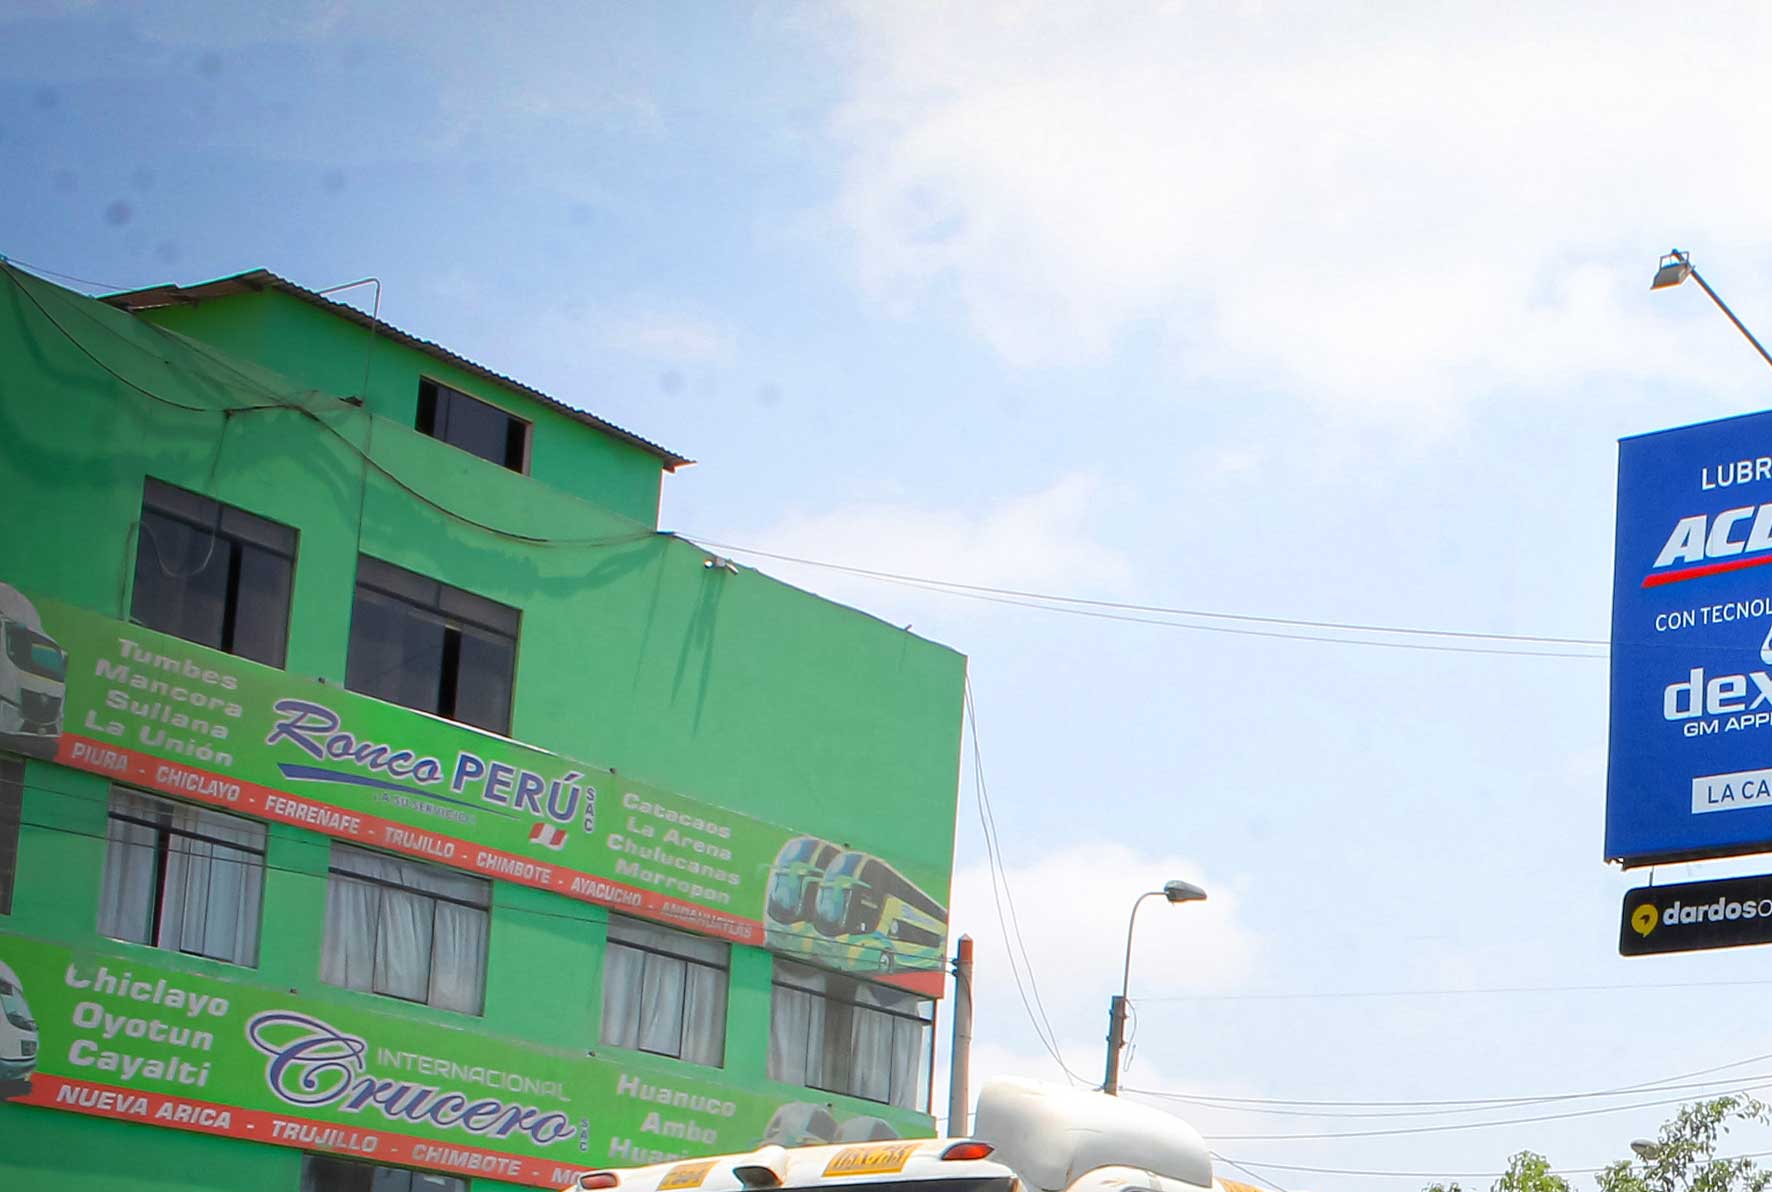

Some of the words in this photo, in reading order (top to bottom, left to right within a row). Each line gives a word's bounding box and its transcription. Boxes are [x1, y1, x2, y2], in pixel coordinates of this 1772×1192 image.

[1654, 610, 1696, 632] CON
[95, 658, 244, 718] Mancora
[118, 637, 239, 690] Tumbes
[84, 709, 125, 738] La
[139, 722, 235, 768] Unión
[105, 690, 229, 740] Sullana
[1683, 718, 1720, 738] GM
[267, 699, 444, 783] Ronco
[451, 749, 586, 823] PERÚ
[583, 786, 597, 834] SAC
[622, 792, 731, 839] Catacaos
[1706, 783, 1736, 805] LA
[71, 742, 129, 772] PIURA
[155, 766, 241, 802] CHICLAYO
[264, 792, 361, 835] FERREÑAFE
[385, 826, 455, 858] TRUJILLO
[476, 851, 552, 885] CHIMBOTE
[570, 875, 642, 908] AYACUCHO
[626, 813, 655, 839] La
[663, 827, 732, 861] Arena
[607, 833, 741, 887] Chulucanas
[615, 858, 731, 904] Morropon
[64, 961, 230, 1018] Chiclayo
[71, 1001, 214, 1052] Oyotun
[67, 1038, 213, 1087] Cayalti
[245, 1009, 577, 1146] Crucero
[377, 1046, 572, 1101] INTERNACIONAL
[616, 1073, 737, 1117] Huanuco
[56, 1083, 149, 1117] NUEVA
[154, 1103, 233, 1130] ARICA
[270, 1119, 379, 1153] TRUJILLO
[411, 1143, 522, 1177] CHIMBOTE
[640, 1111, 719, 1145] Ambo
